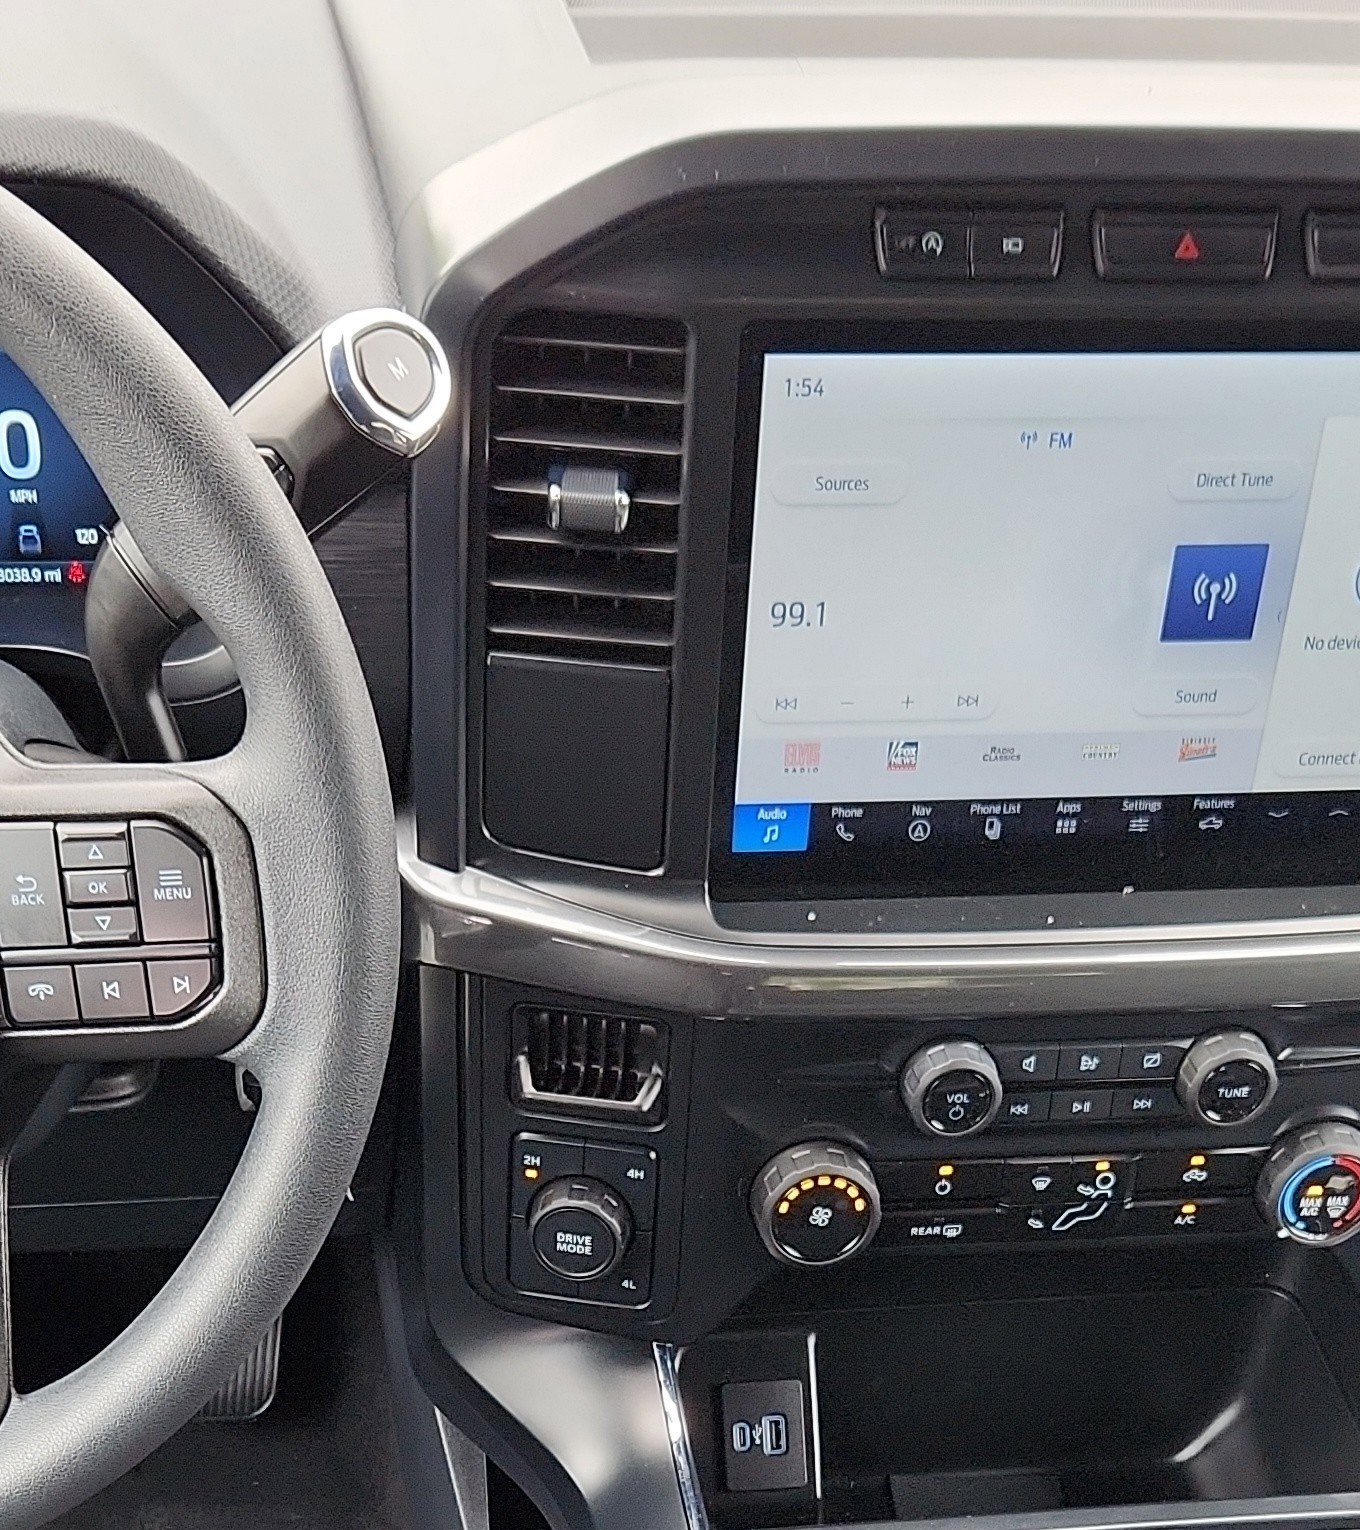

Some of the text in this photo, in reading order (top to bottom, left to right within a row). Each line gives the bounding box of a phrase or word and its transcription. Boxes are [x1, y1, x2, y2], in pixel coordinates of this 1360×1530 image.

[387, 356, 409, 382] M
[785, 378, 825, 398] 1:54
[1048, 432, 1073, 449] FM
[814, 475, 870, 493] Sources
[1196, 471, 1274, 488] Direct Tune
[9, 489, 38, 504] MPH
[74, 528, 99, 545] 120
[770, 602, 827, 628] 99.1
[1304, 635, 1323, 650] No
[1175, 690, 1218, 704] Sound
[1298, 752, 1357, 766] Connect
[970, 804, 1021, 815] Phone List
[1056, 801, 1081, 814] Apps
[1122, 800, 1161, 812] Settings
[1193, 799, 1234, 810] Features
[757, 808, 786, 820] Audio
[831, 807, 863, 818] Phone
[912, 805, 932, 818] Nav
[89, 882, 107, 894] OK
[154, 887, 192, 900] MENU
[11, 893, 44, 905] BACK
[946, 1093, 970, 1104] VOL
[1217, 1087, 1251, 1099] TUNE
[523, 1155, 540, 1167] 2H
[626, 1169, 645, 1180] 4H
[1299, 1197, 1323, 1208] MAX
[1326, 1195, 1350, 1207] MAX
[1299, 1208, 1320, 1217] A/C
[1174, 1216, 1195, 1226] A/C
[910, 1226, 941, 1237] REAR
[556, 1231, 593, 1246] DRIVE
[556, 1243, 593, 1256] MODE
[621, 1279, 636, 1290] 4L
